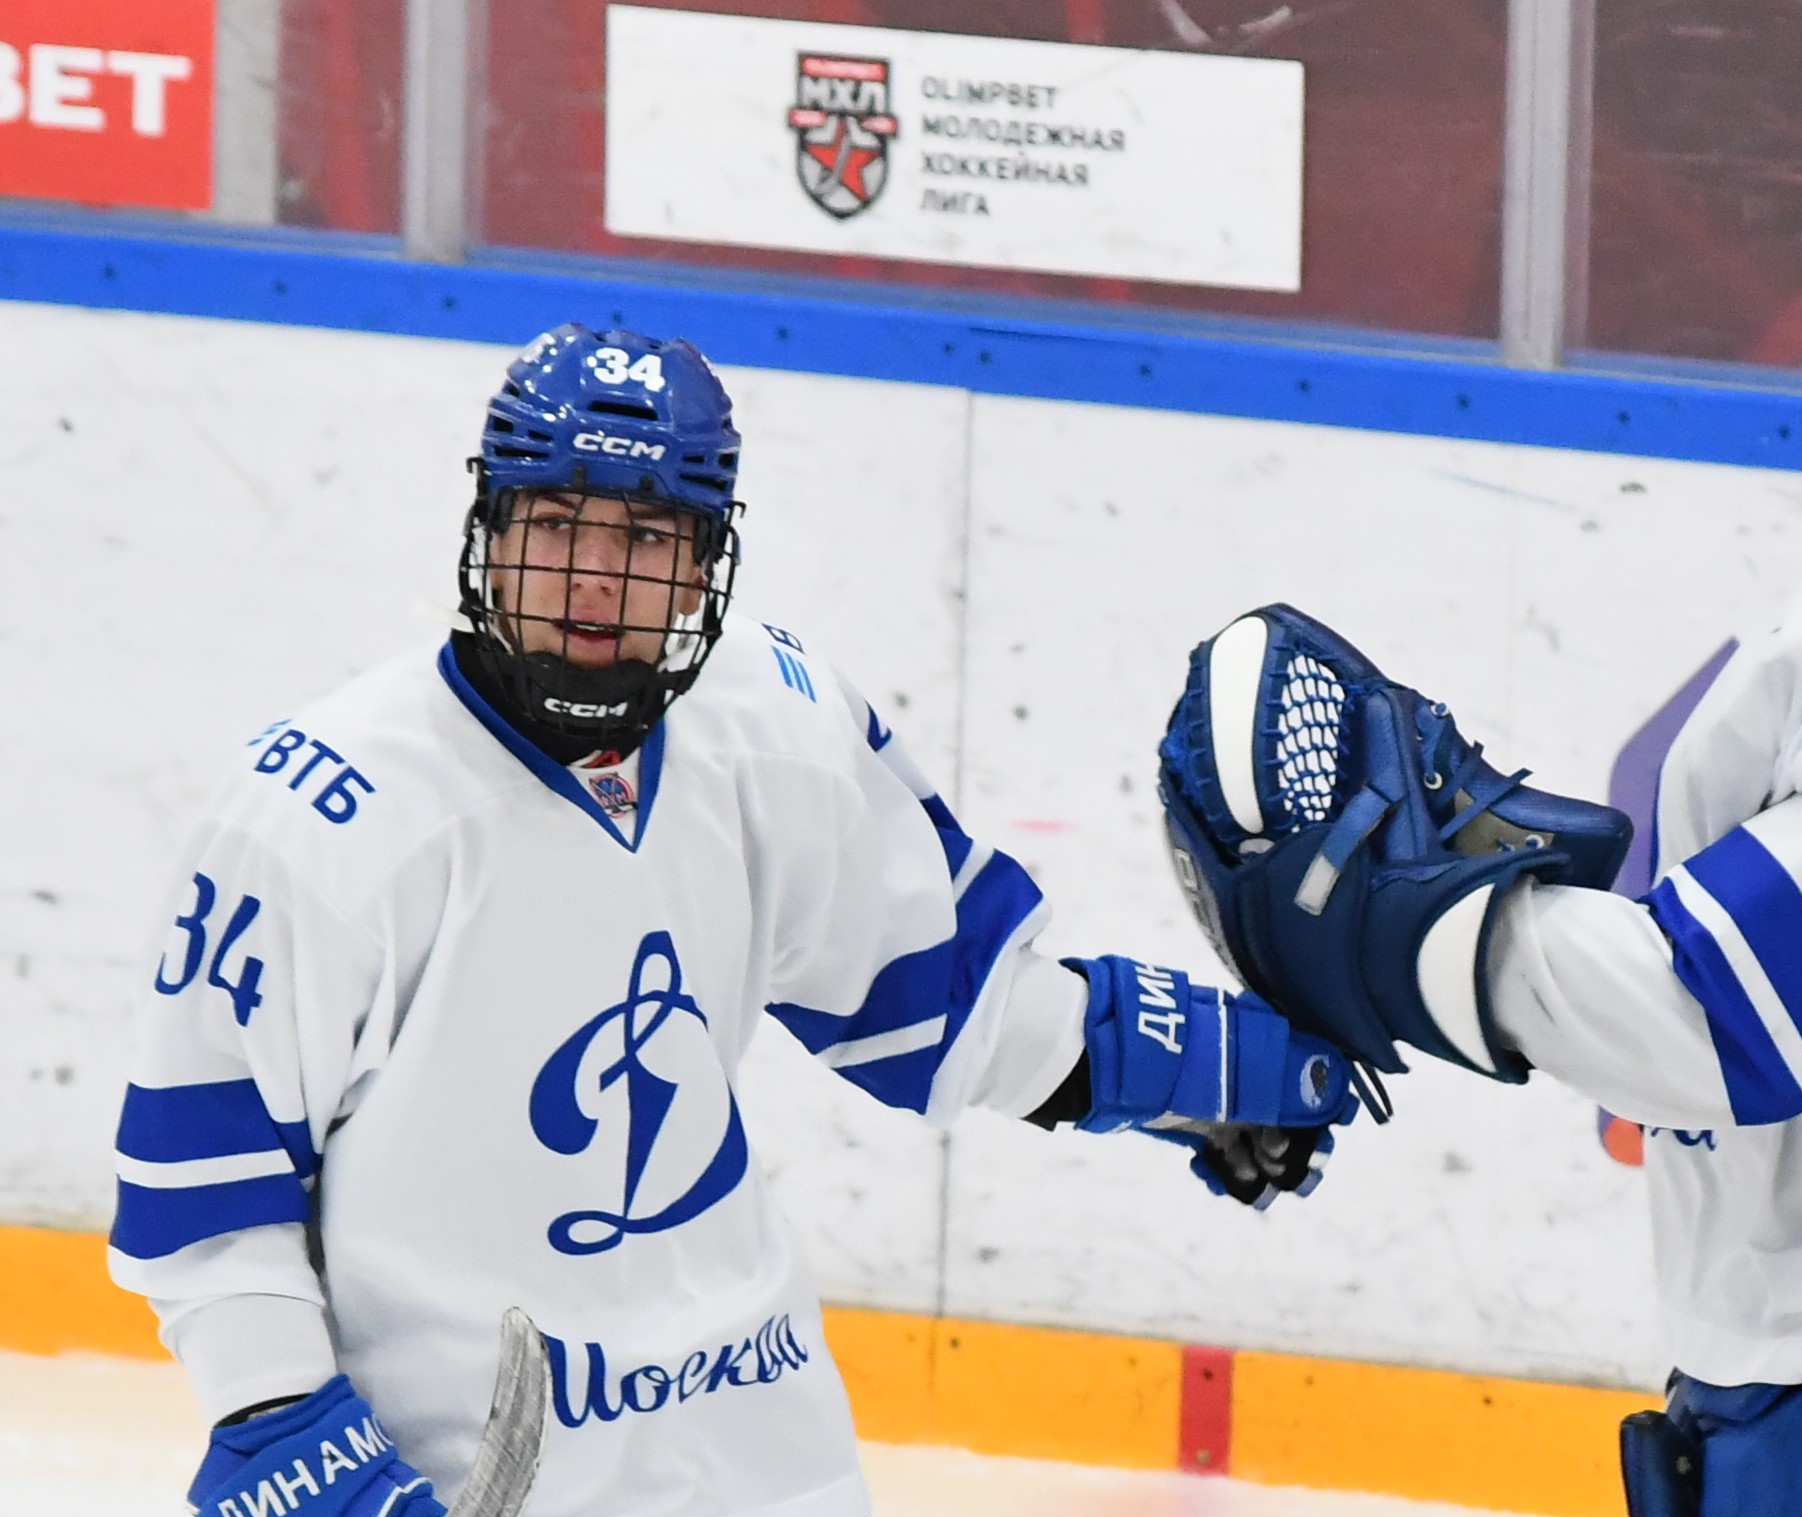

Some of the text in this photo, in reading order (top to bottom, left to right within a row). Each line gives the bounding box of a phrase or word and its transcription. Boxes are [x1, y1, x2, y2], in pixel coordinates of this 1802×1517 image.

[921, 76, 1058, 108] OLIMPBET
[921, 115, 1126, 151] МОЛОДЕЖНАЯ
[921, 152, 1089, 186] ХОККЕЙНАЯ
[920, 188, 990, 215] ЛИГА
[592, 347, 664, 391] 34
[573, 430, 667, 461] CCM
[543, 696, 628, 718] CCM
[255, 728, 377, 825] ВТБ
[155, 872, 263, 1027] 34
